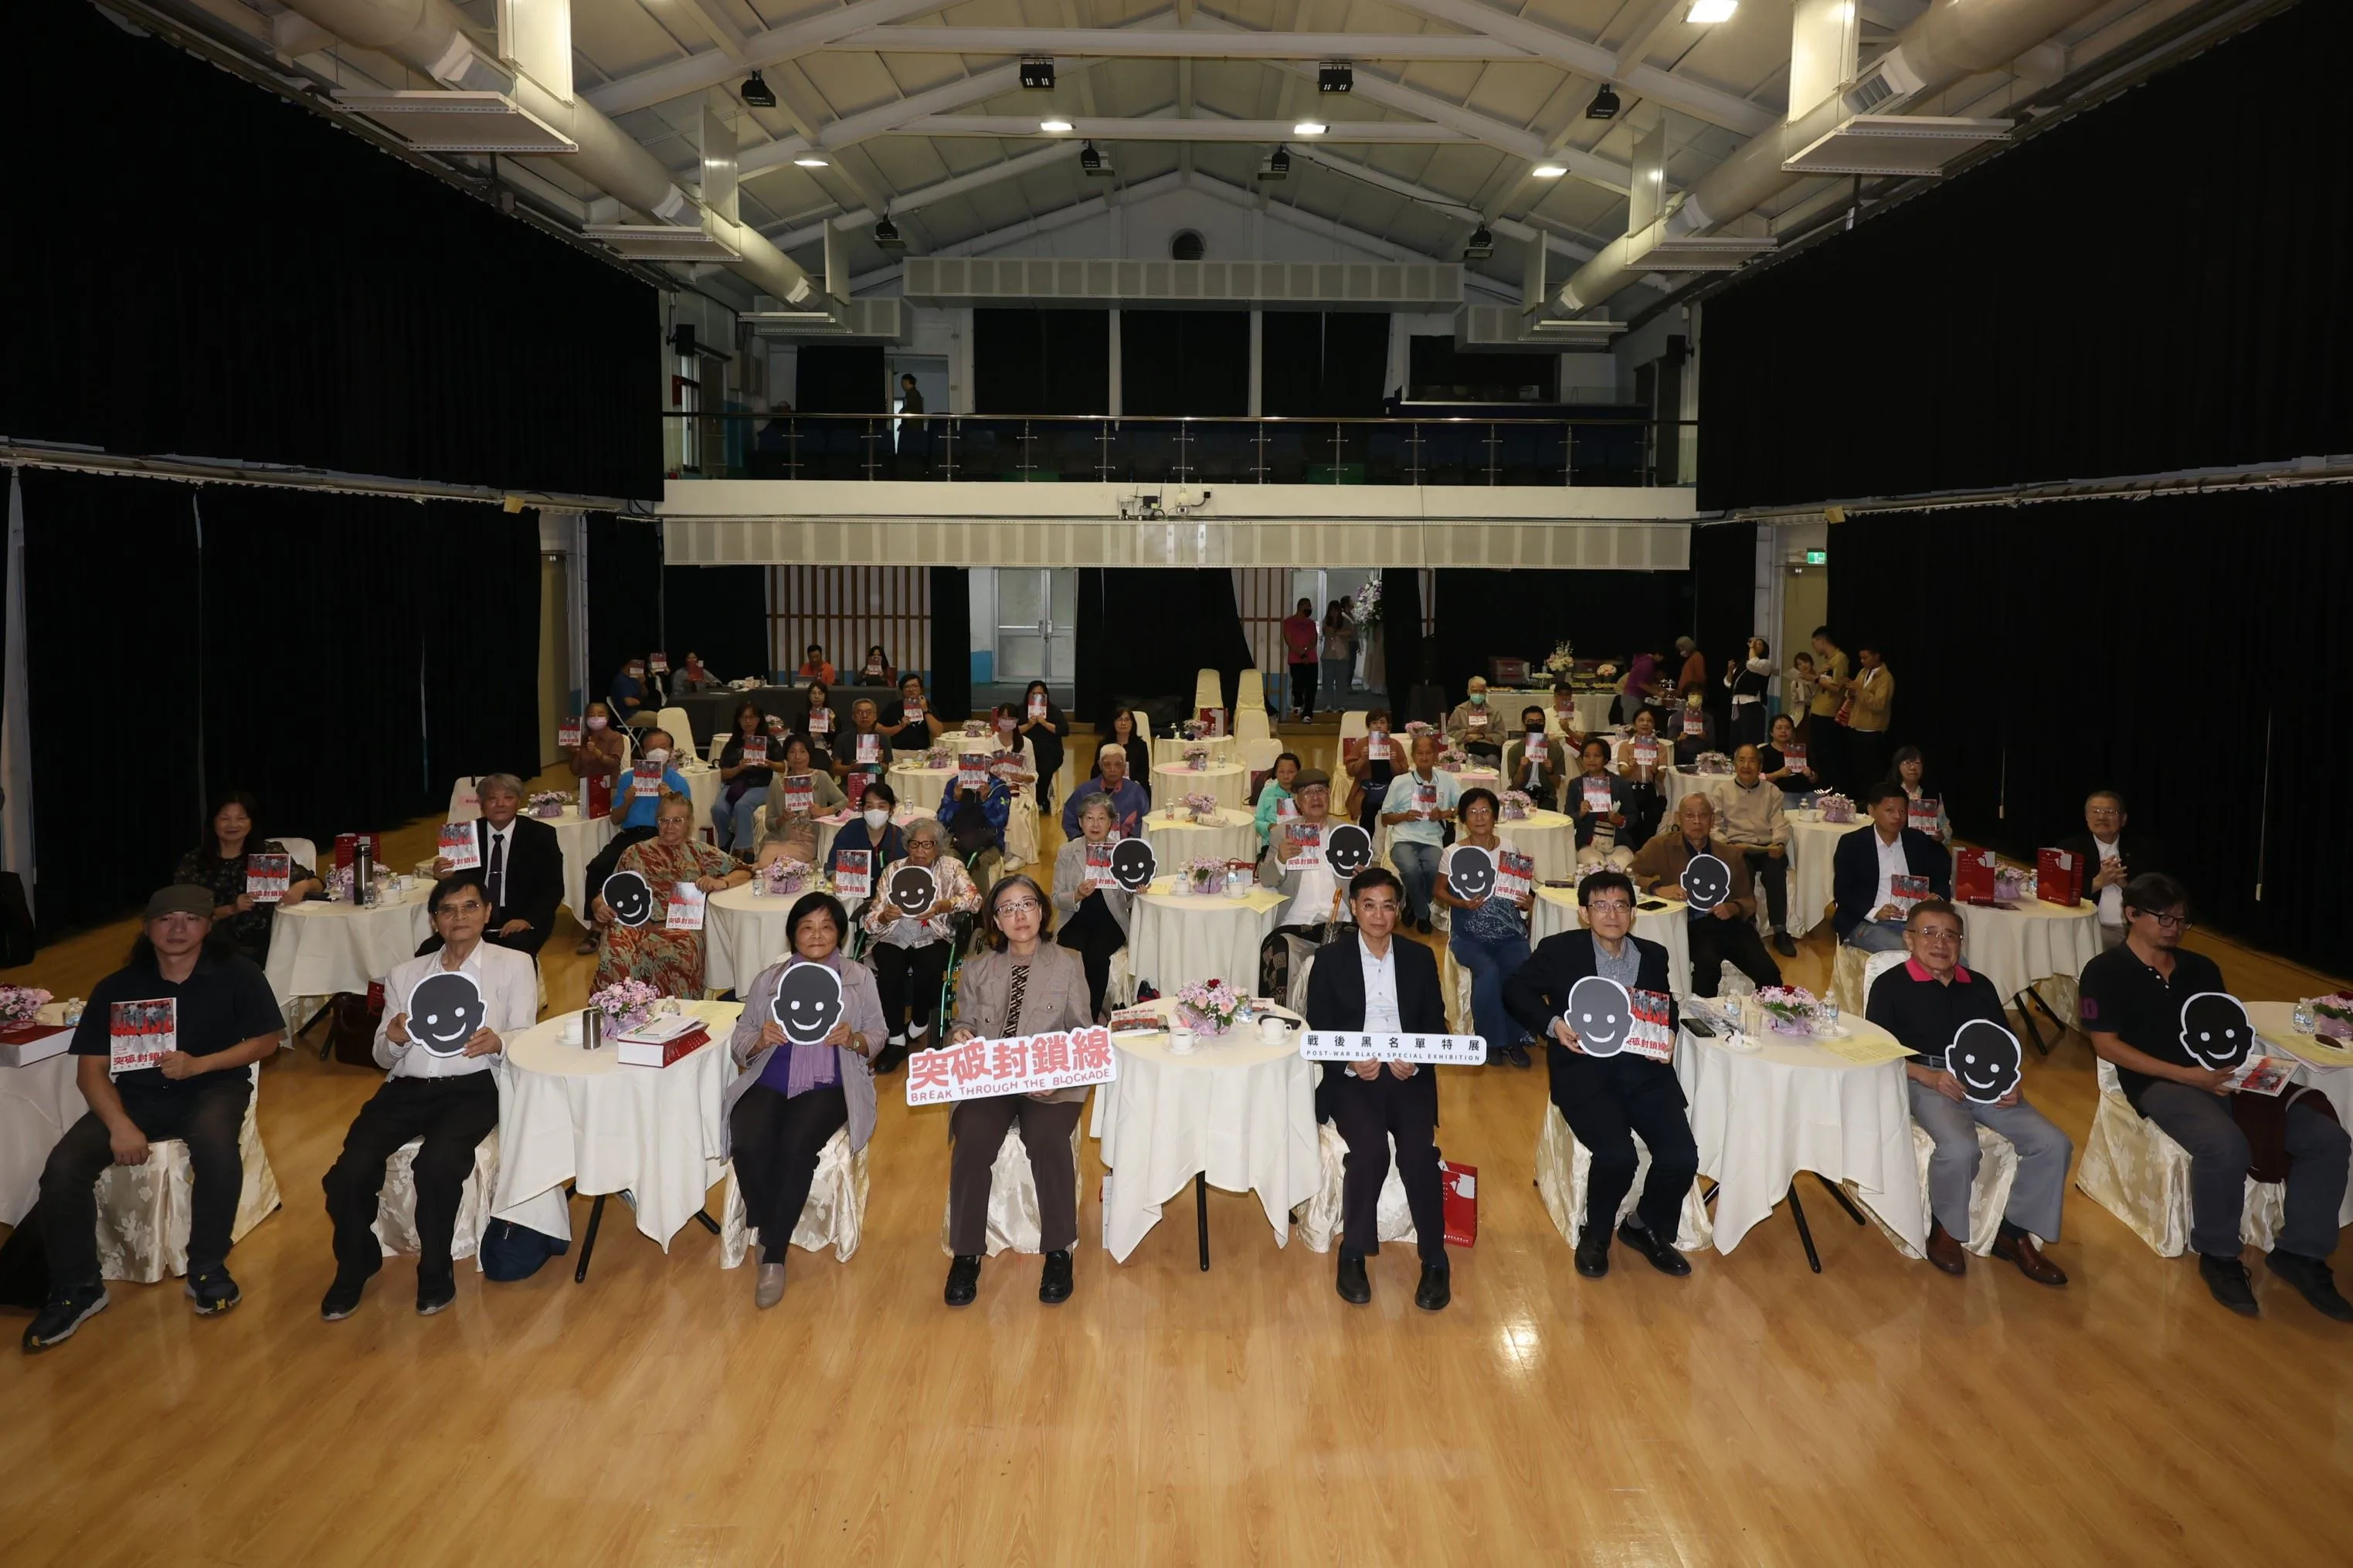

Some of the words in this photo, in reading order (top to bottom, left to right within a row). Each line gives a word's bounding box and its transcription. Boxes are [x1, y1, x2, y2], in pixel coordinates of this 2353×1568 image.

[1307, 1034, 1480, 1051] 戰後黑名單特展
[911, 1029, 1112, 1091] 突破封鎖線
[911, 1089, 952, 1102] BREAK
[959, 1081, 1018, 1096] THROUGH
[1024, 1078, 1046, 1089] THE
[1052, 1068, 1110, 1086] BLOCKADE
